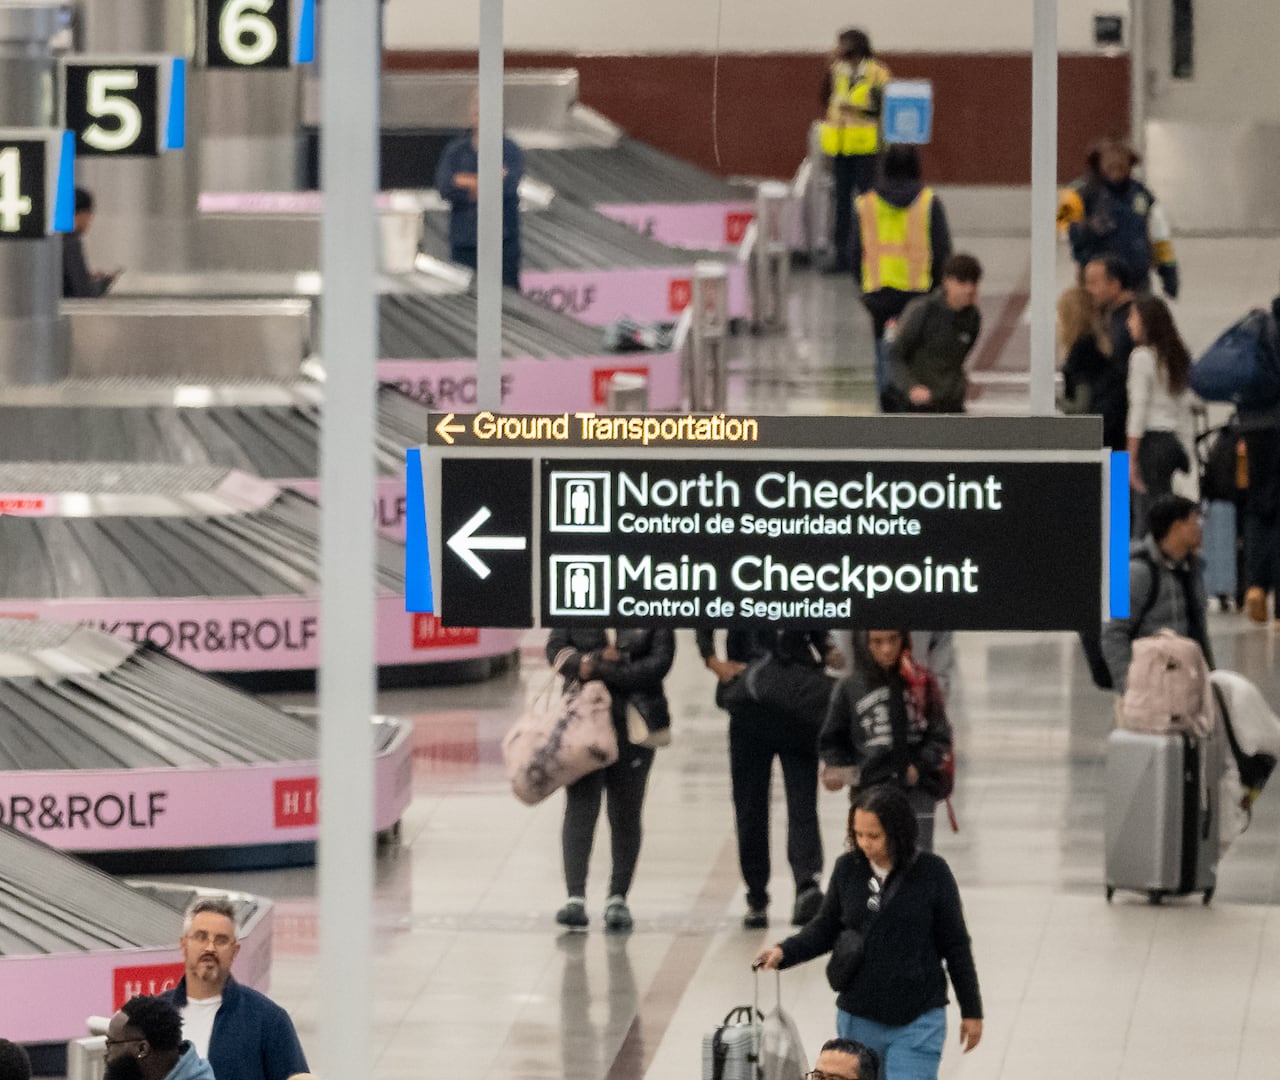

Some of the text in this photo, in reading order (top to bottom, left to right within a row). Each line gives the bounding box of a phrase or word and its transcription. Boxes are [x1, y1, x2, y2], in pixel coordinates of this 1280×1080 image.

[219, 0, 278, 65] 6
[81, 69, 142, 151] 5
[473, 414, 758, 444] Ground Transportation
[617, 471, 1002, 515] North Checkpoint
[617, 513, 921, 538] Control de Seguridad Norte
[617, 556, 979, 600] Main Checkpoint
[617, 597, 851, 621] Control de Seguridad
